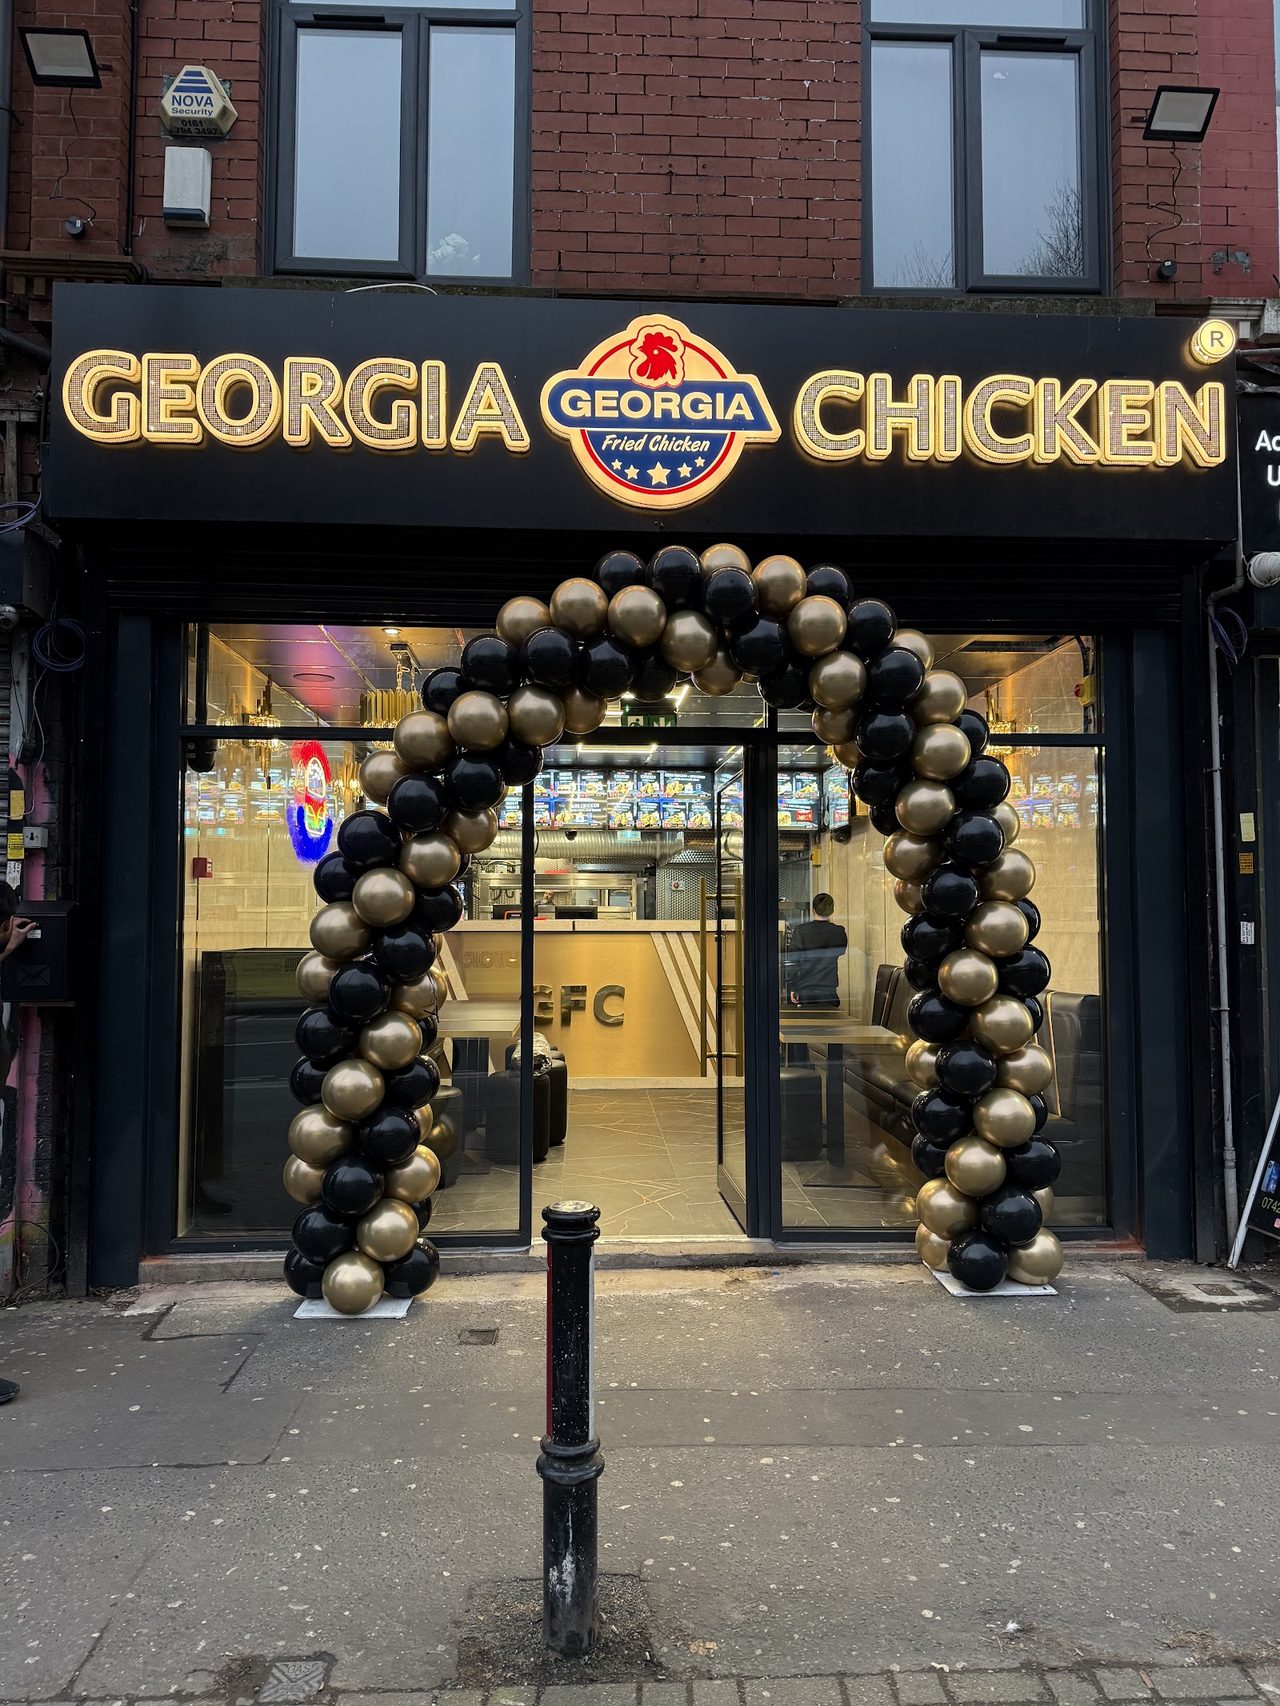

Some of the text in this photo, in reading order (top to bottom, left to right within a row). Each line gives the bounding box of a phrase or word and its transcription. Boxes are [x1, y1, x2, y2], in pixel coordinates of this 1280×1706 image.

[172, 95, 213, 107] NOVA
[172, 107, 213, 116] Security
[182, 119, 203, 127] 0161
[62, 349, 1227, 468] GEORGIA CHICKEN
[560, 389, 755, 421] GEORGIA
[601, 434, 711, 453] Fried Chicken
[288, 1664, 311, 1675] GAS
